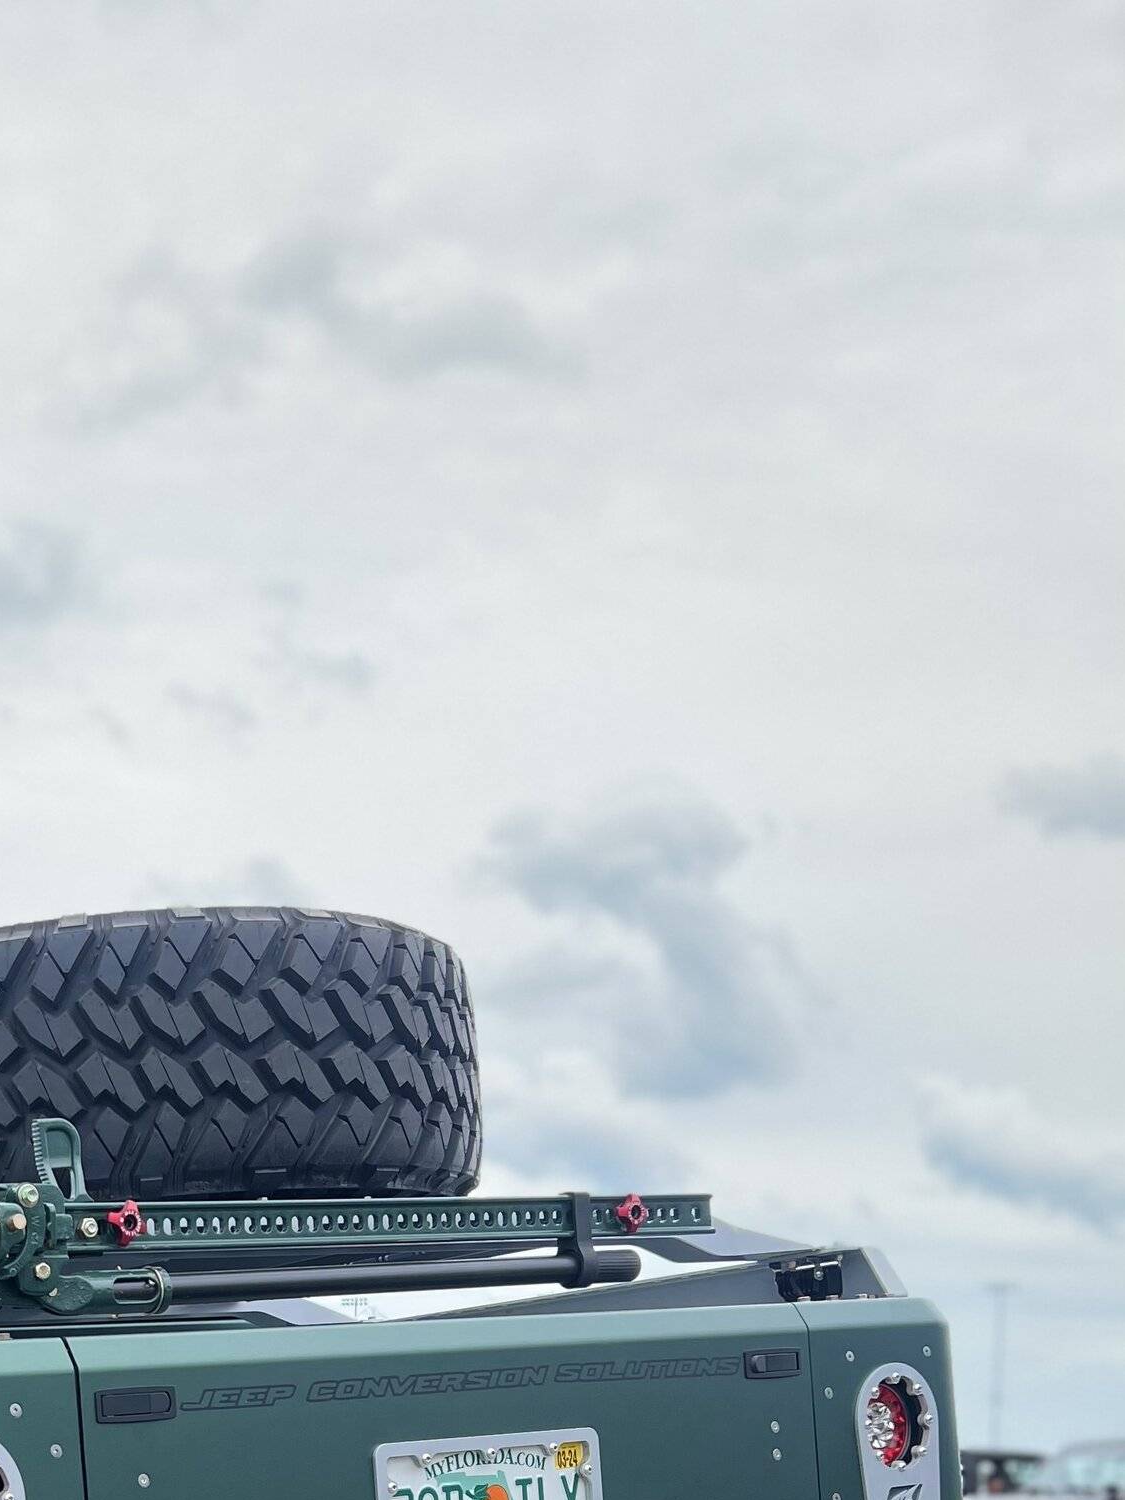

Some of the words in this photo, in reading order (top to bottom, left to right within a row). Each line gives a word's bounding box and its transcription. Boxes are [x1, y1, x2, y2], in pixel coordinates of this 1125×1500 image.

[179, 1384, 297, 1411] JEEP
[305, 1364, 550, 1402] CONVERSION
[554, 1356, 742, 1383] SOLUTIONS
[425, 1448, 547, 1479] MYFLORDA.COM
